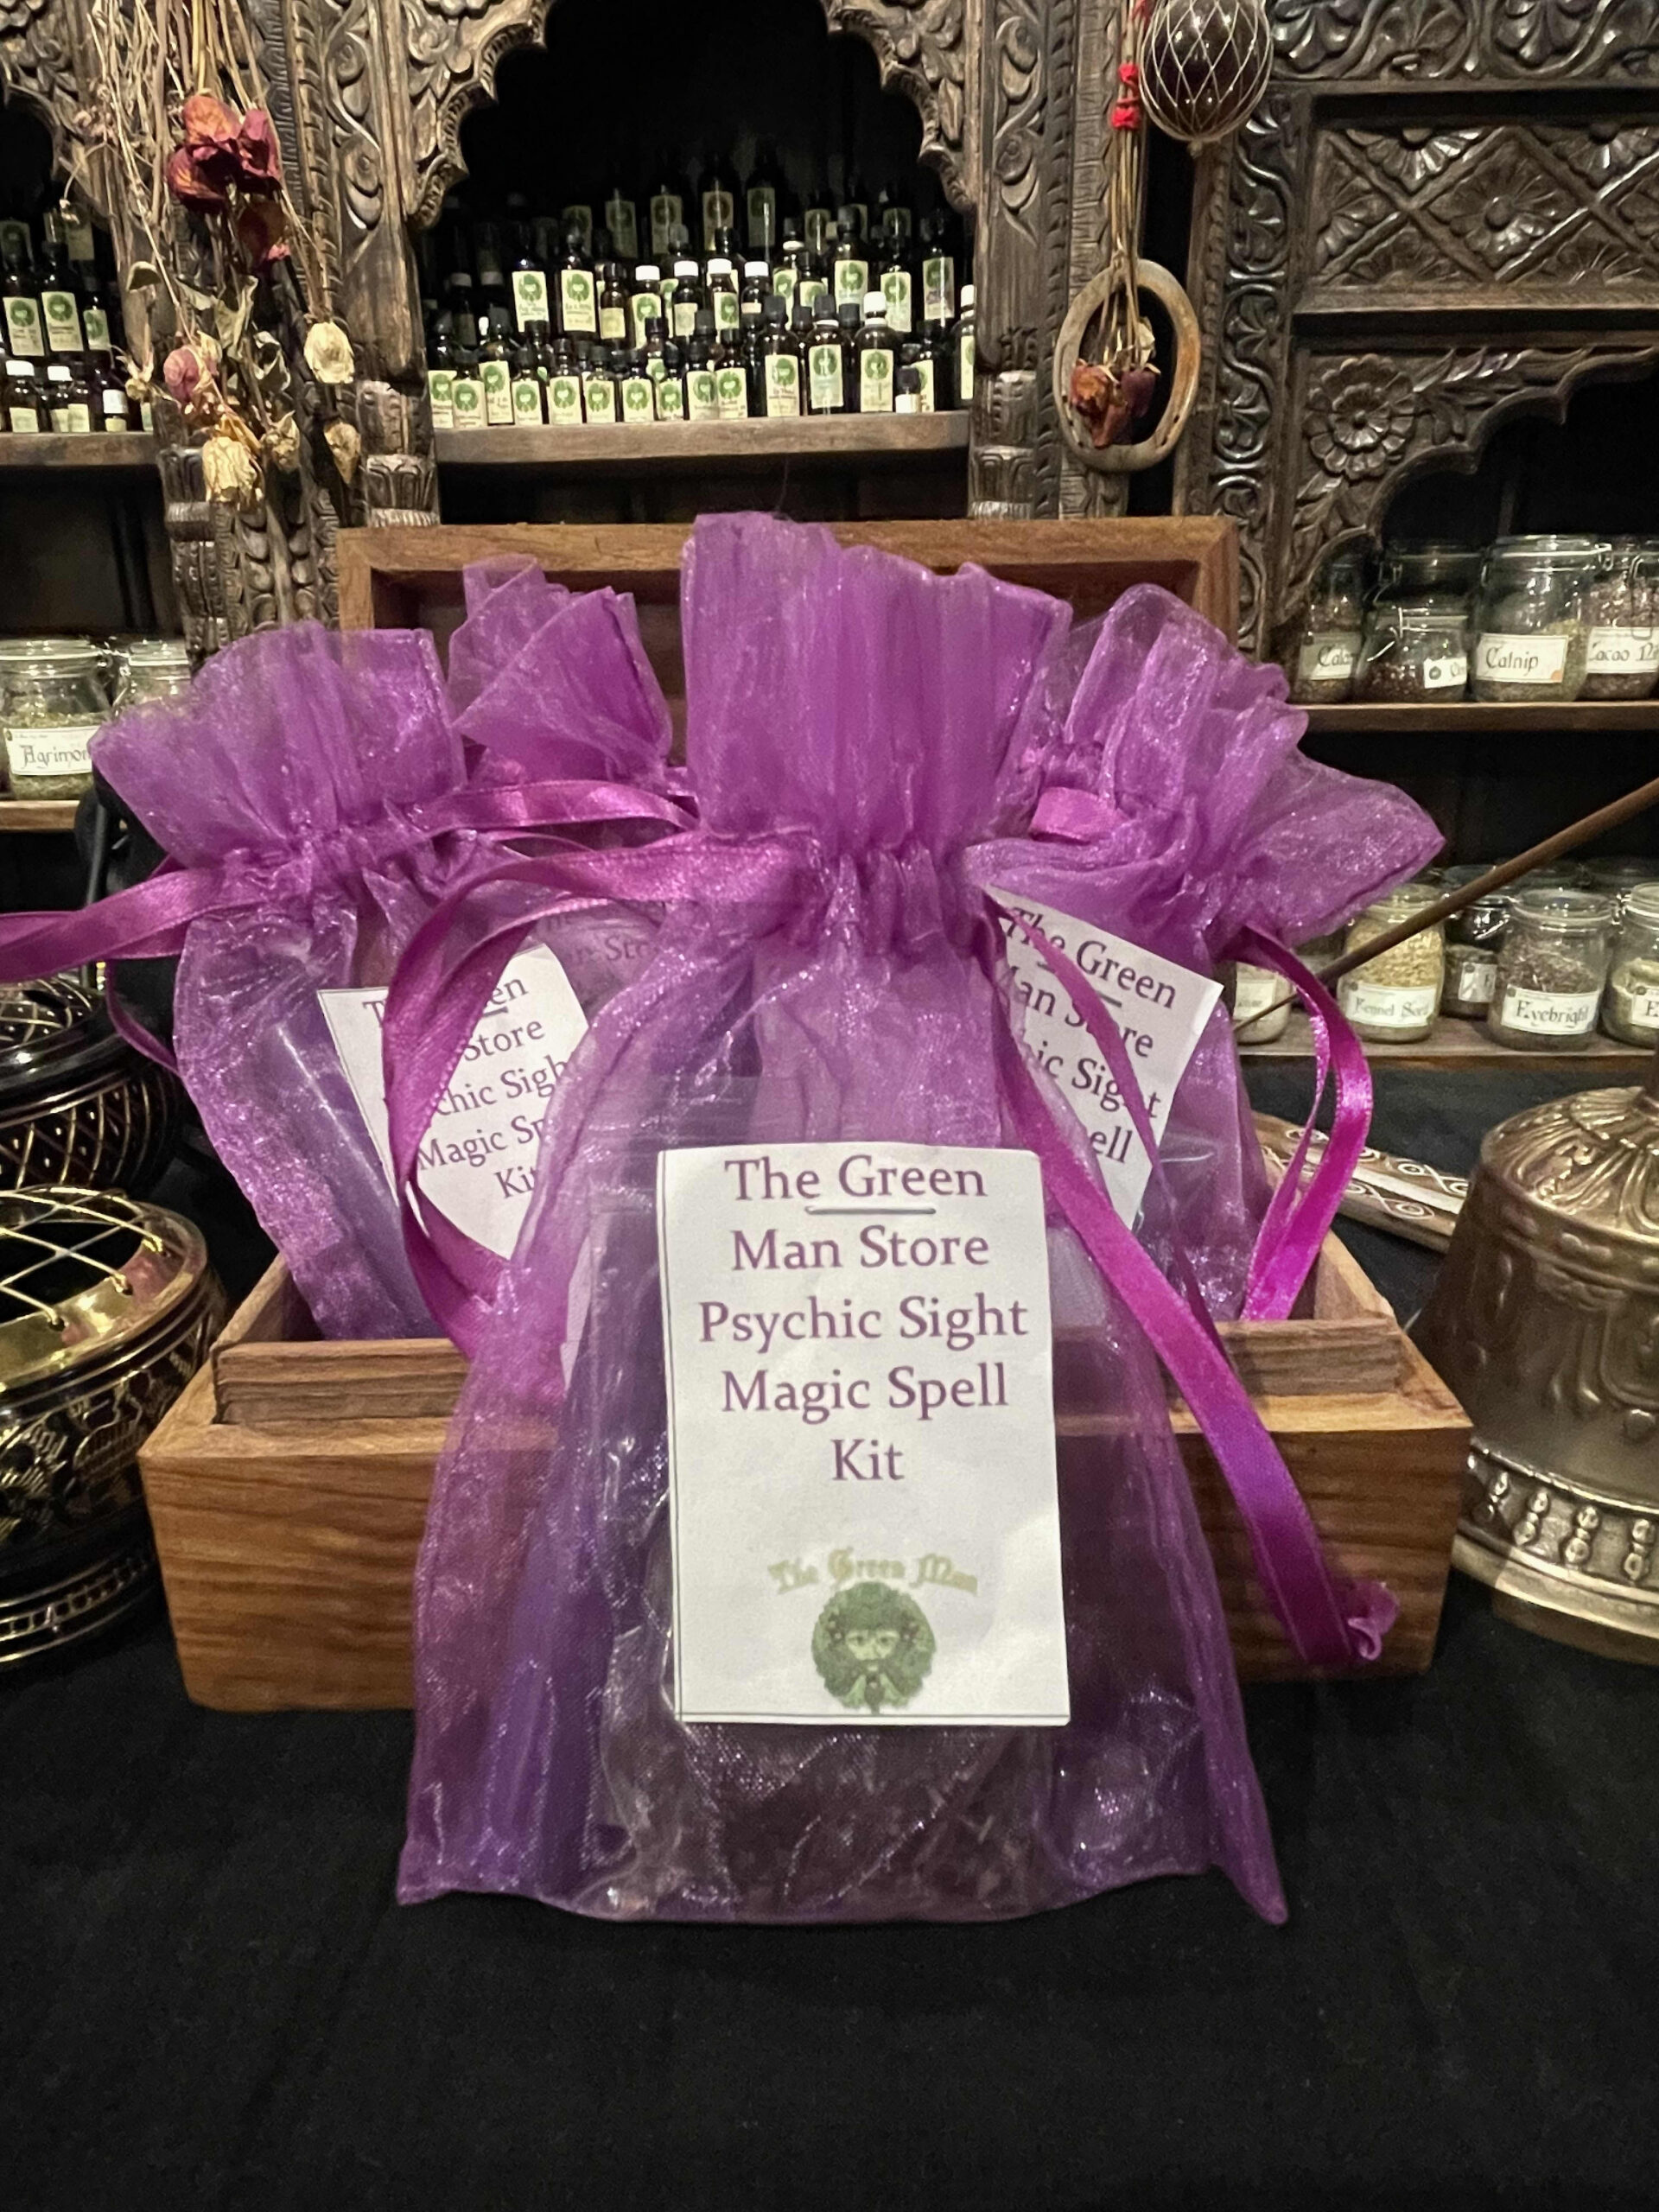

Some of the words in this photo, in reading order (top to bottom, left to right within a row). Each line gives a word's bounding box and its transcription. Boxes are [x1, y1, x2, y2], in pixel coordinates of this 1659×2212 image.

[19, 745, 91, 769] Agrimon
[1076, 940, 1176, 1009] Green
[500, 1055, 567, 1099] Sigh
[1071, 1058, 1161, 1118] Sigt
[418, 1128, 508, 1171] Magic
[493, 1166, 537, 1199] Ki
[724, 1156, 821, 1201] The
[838, 1154, 988, 1198] Green
[730, 1229, 843, 1271] Man
[859, 1224, 989, 1268] Store
[698, 1295, 882, 1354] Psychic
[899, 1293, 1029, 1351] Sight
[721, 1369, 871, 1425] Magic
[887, 1362, 1009, 1421] Spell
[831, 1438, 905, 1482] Kit
